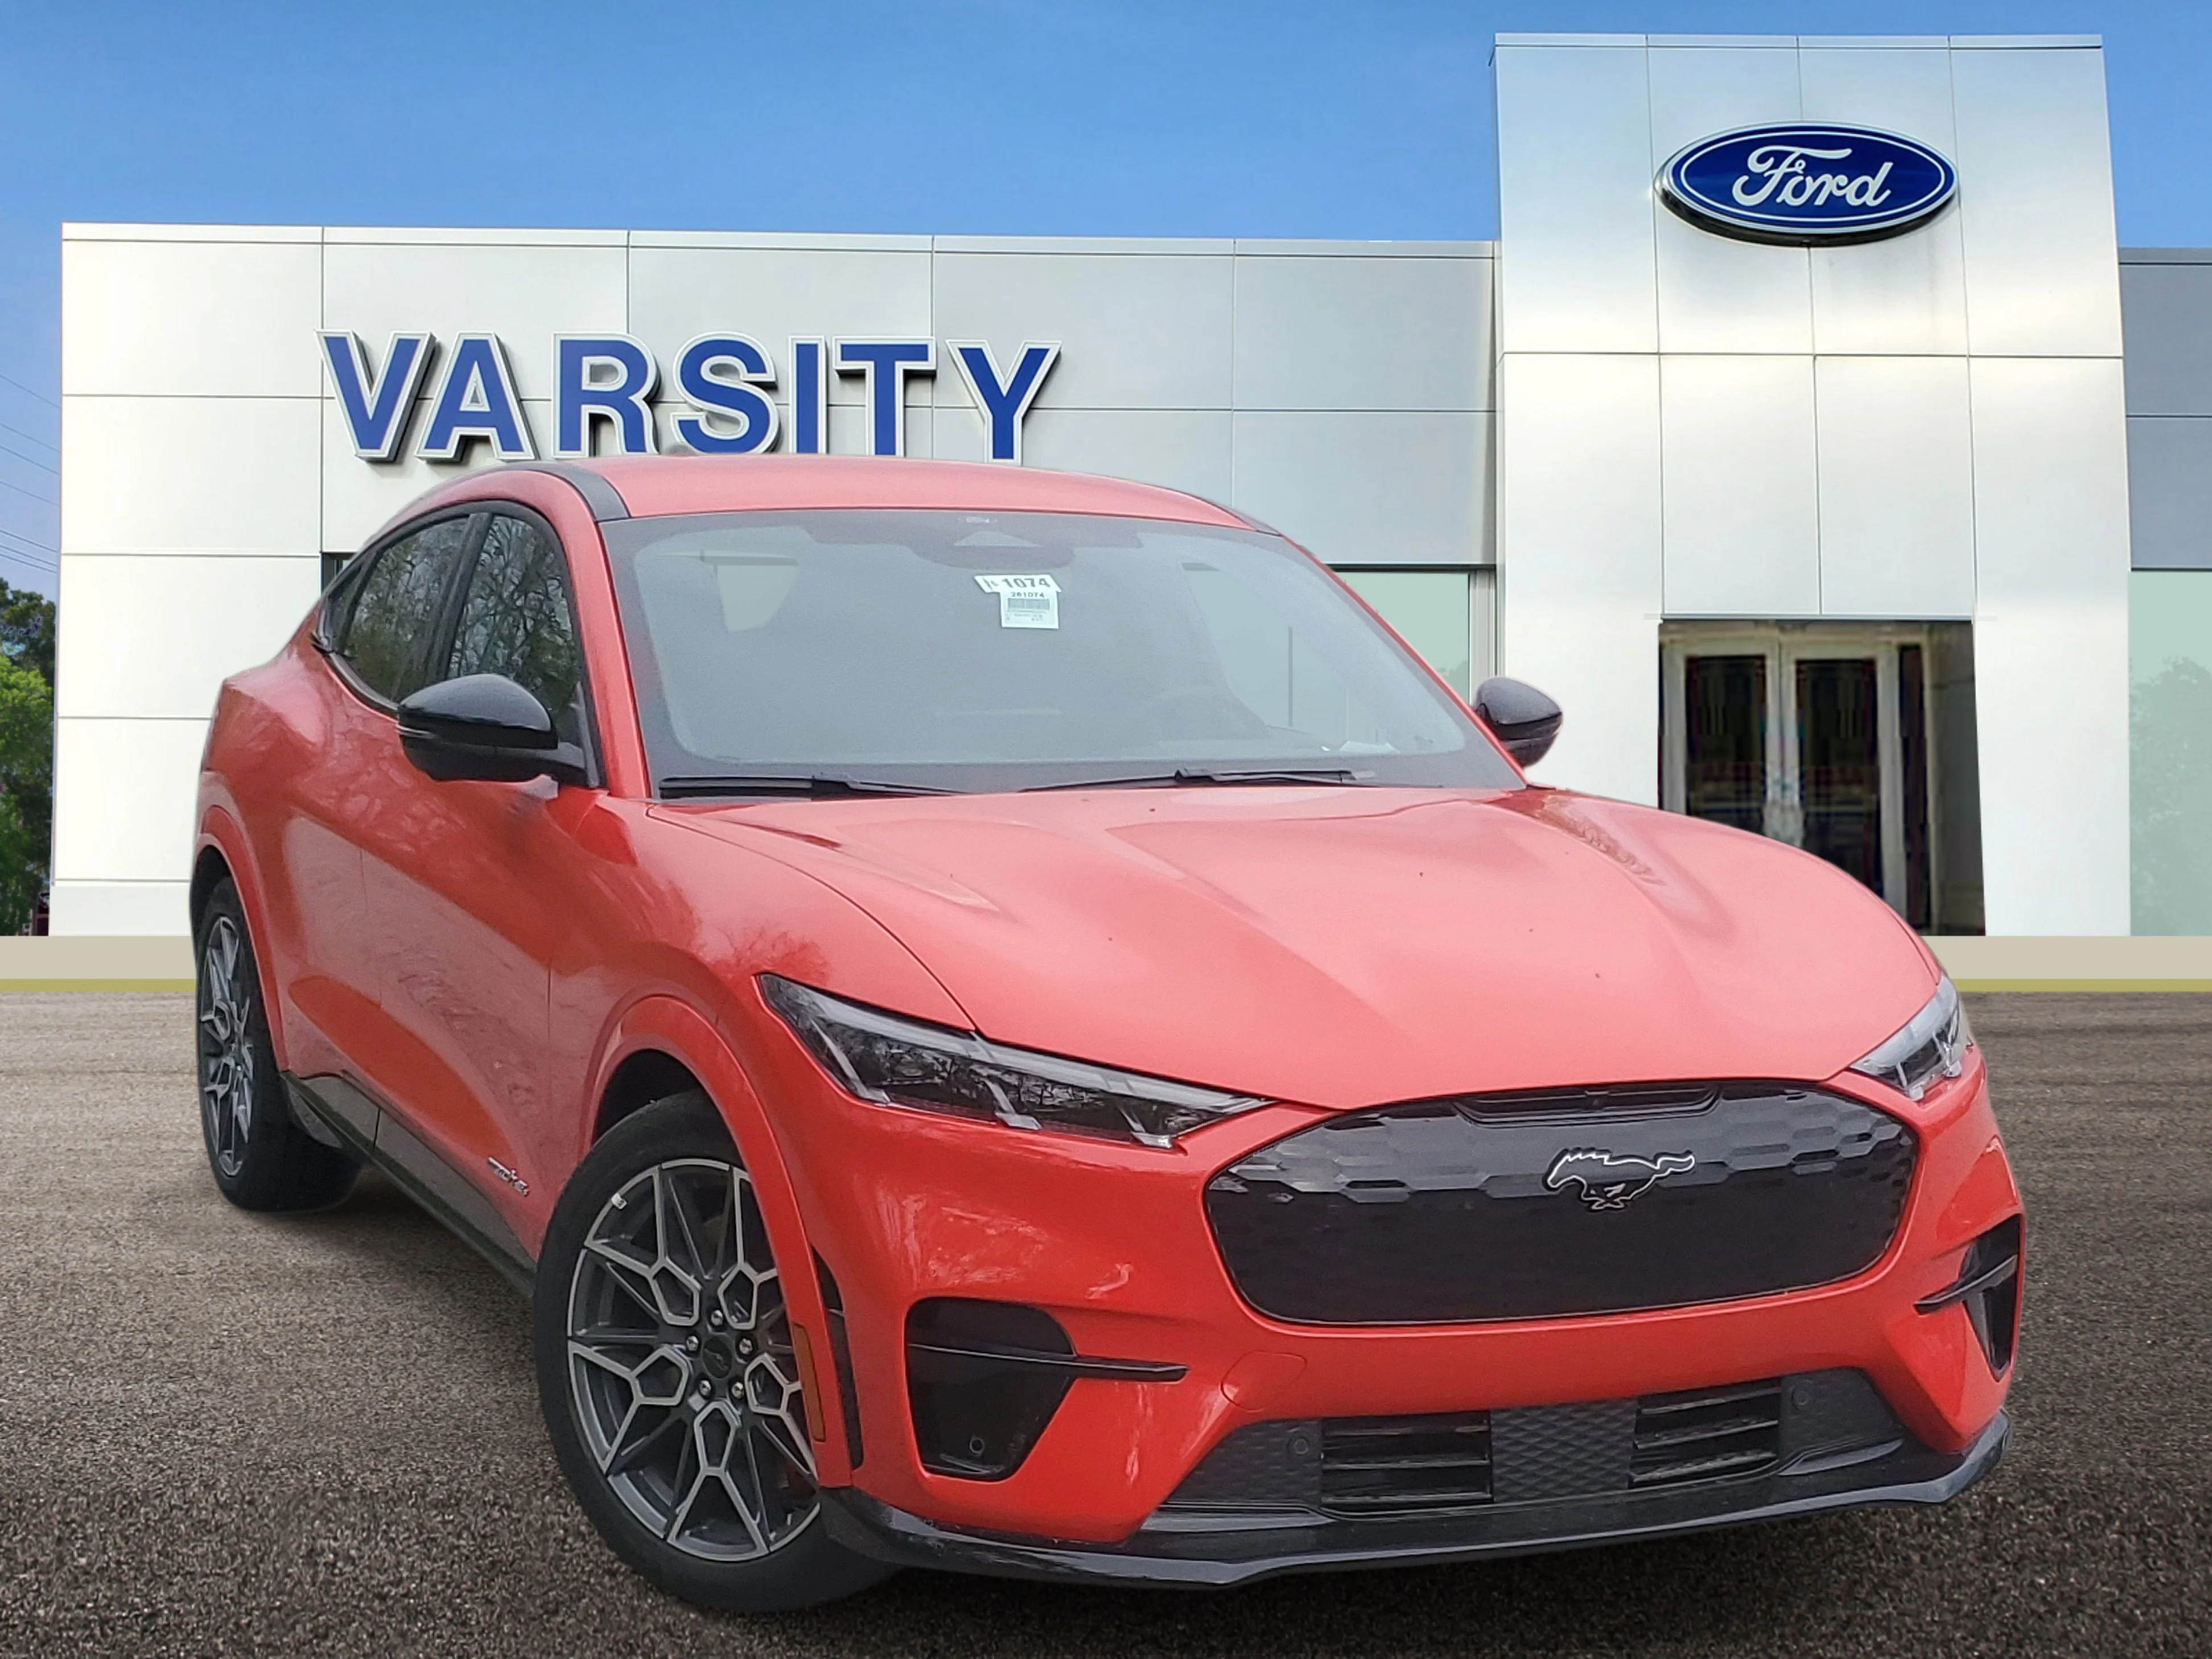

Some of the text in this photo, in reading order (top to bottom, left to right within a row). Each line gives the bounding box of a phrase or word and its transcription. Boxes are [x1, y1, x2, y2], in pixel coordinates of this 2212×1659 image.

[1732, 145, 1893, 207] Ford
[315, 330, 1061, 462] VARSITY
[1002, 578, 1051, 588] 1074
